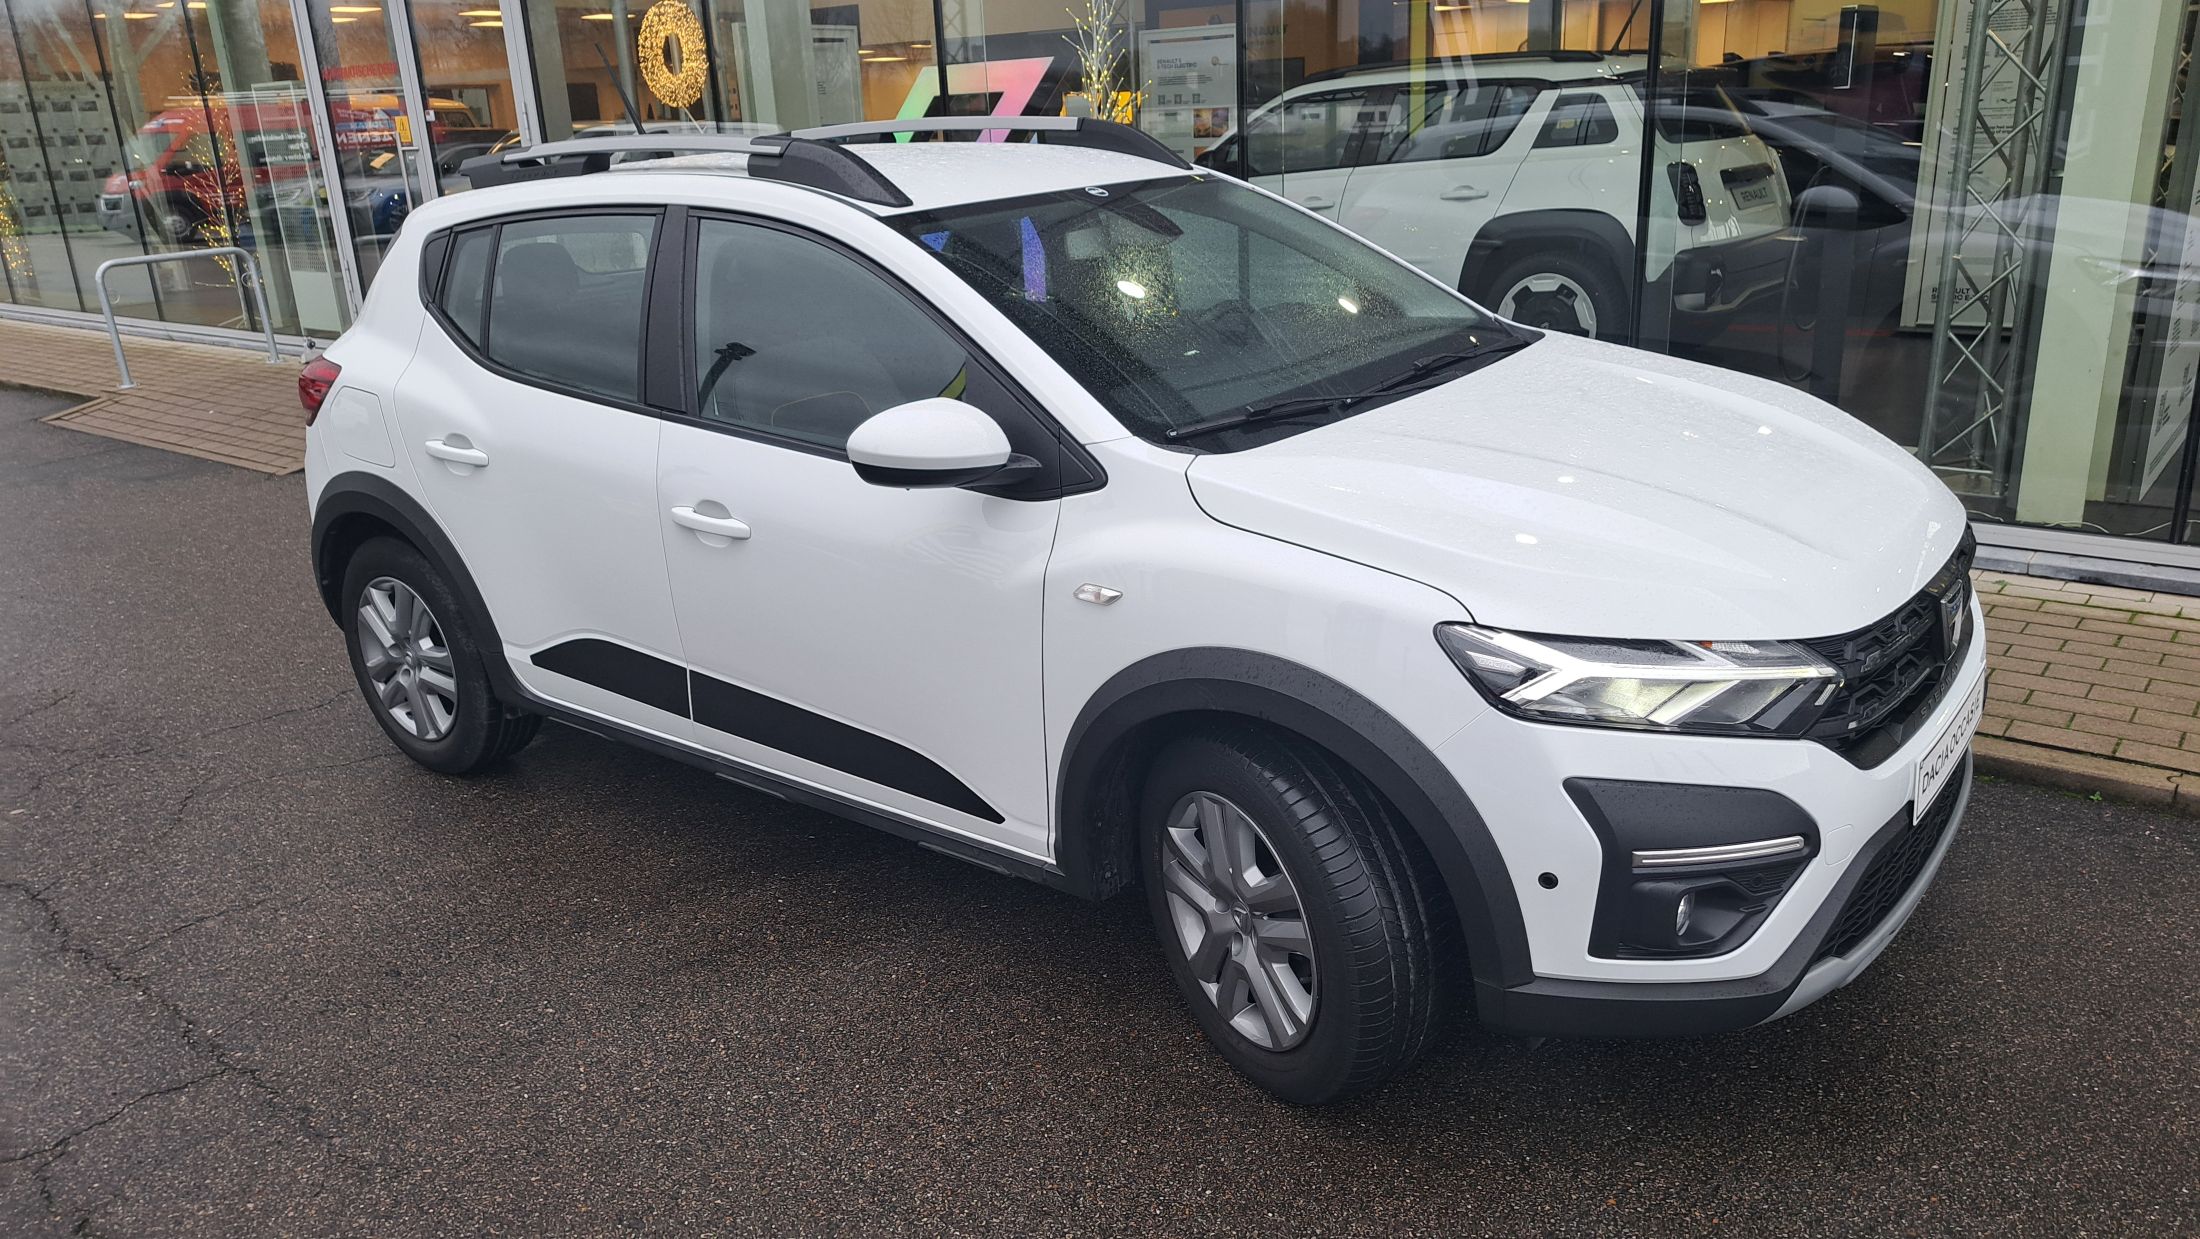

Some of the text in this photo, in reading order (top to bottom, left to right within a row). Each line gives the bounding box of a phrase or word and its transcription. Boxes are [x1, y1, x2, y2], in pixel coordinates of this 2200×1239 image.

[1740, 186, 1768, 202] RENAULT
[1930, 293, 1963, 302] SIC
[1931, 287, 1971, 295] RULT
[1478, 657, 1512, 670] DACIA
[1922, 688, 1981, 794] DACIA OCCASIE
